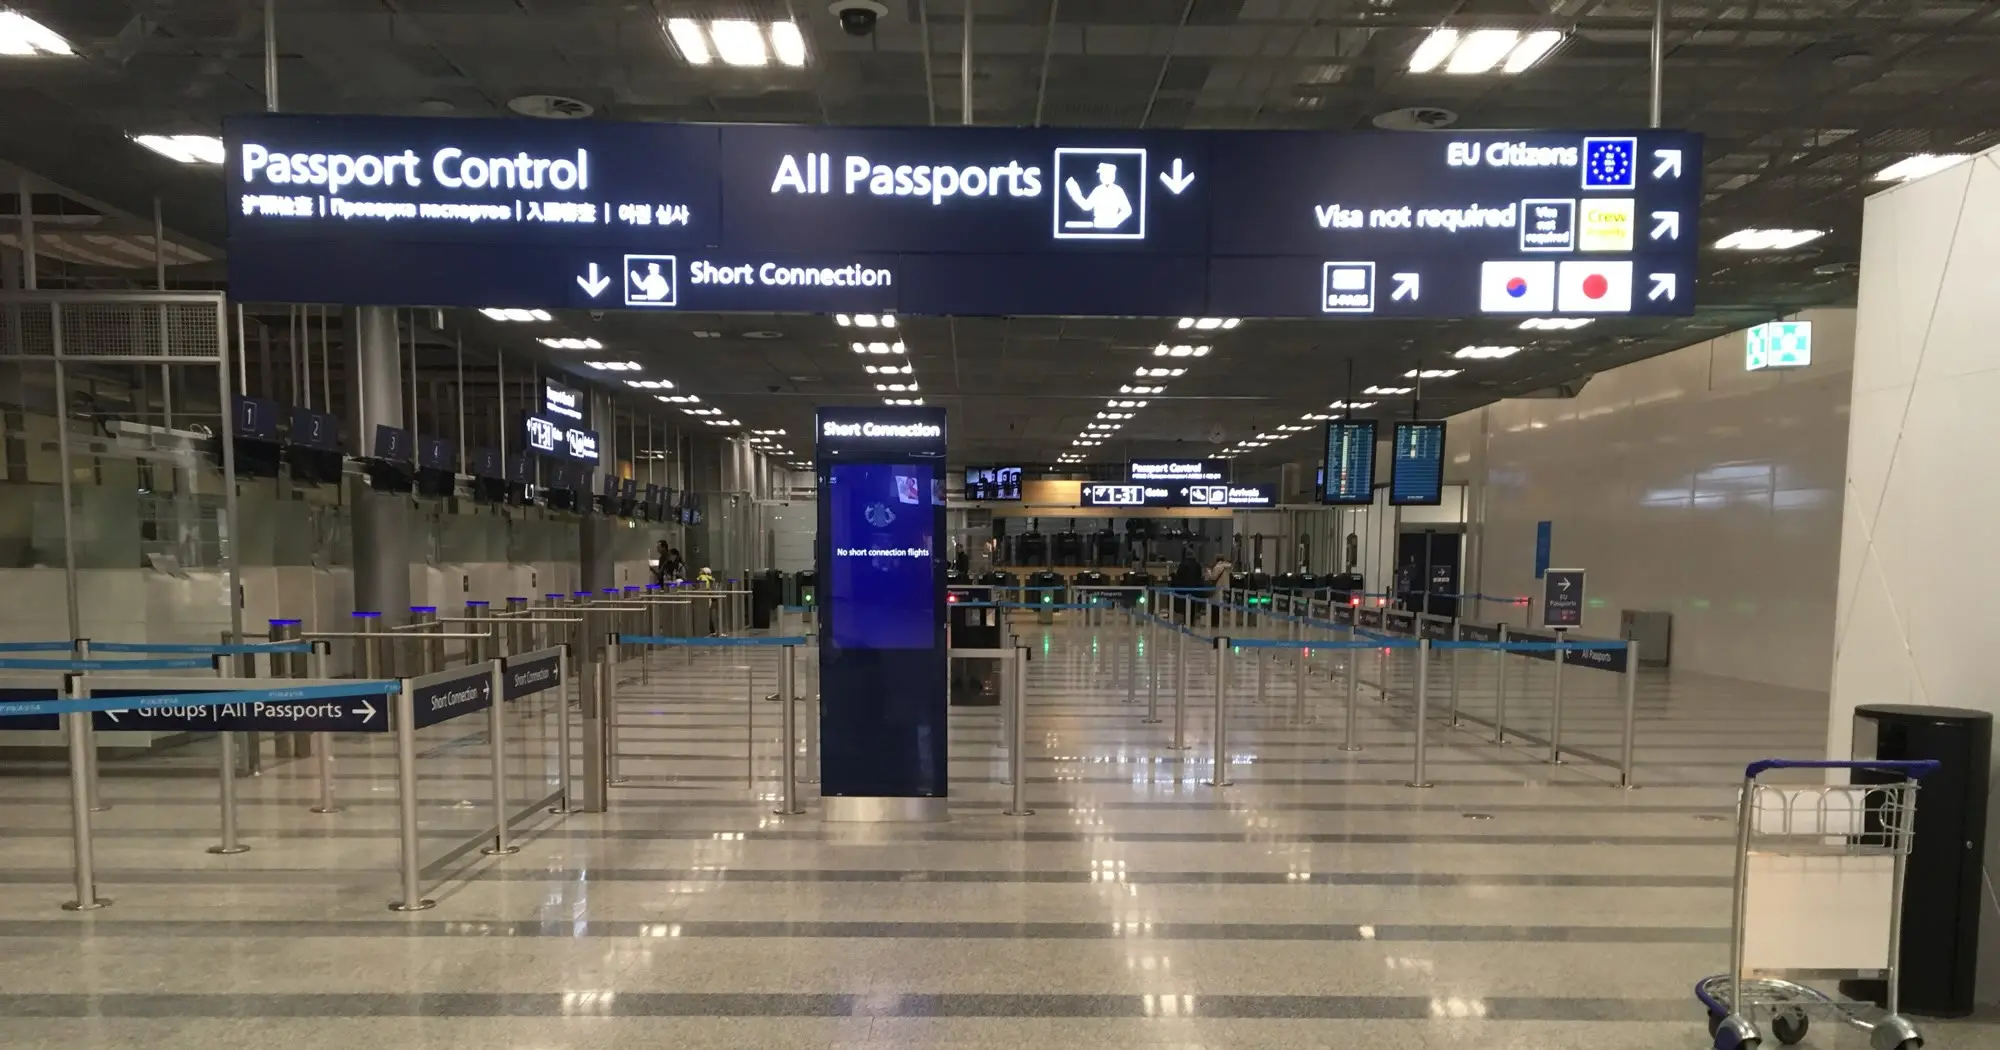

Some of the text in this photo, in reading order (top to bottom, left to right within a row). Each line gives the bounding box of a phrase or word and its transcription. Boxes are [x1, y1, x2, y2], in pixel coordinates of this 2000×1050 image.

[1447, 141, 1577, 168] EU Citizens
[242, 144, 588, 194] Passport Control
[770, 153, 1042, 205] All Passports
[1315, 203, 1516, 233] Visa not required
[1588, 209, 1627, 223] Crew
[690, 260, 892, 287] Short Connection
[247, 408, 252, 425] 1
[313, 420, 319, 437] 2
[823, 421, 940, 437] Short Connection
[390, 436, 396, 450] 3
[1132, 463, 1202, 473] Passport Control
[1145, 488, 1168, 497] Gates
[837, 548, 929, 558] No short connection flights
[1590, 650, 1612, 663] Passports
[514, 668, 549, 687] Short Connection
[431, 686, 478, 711] Short Connection
[138, 701, 342, 721] Groups All Passports
